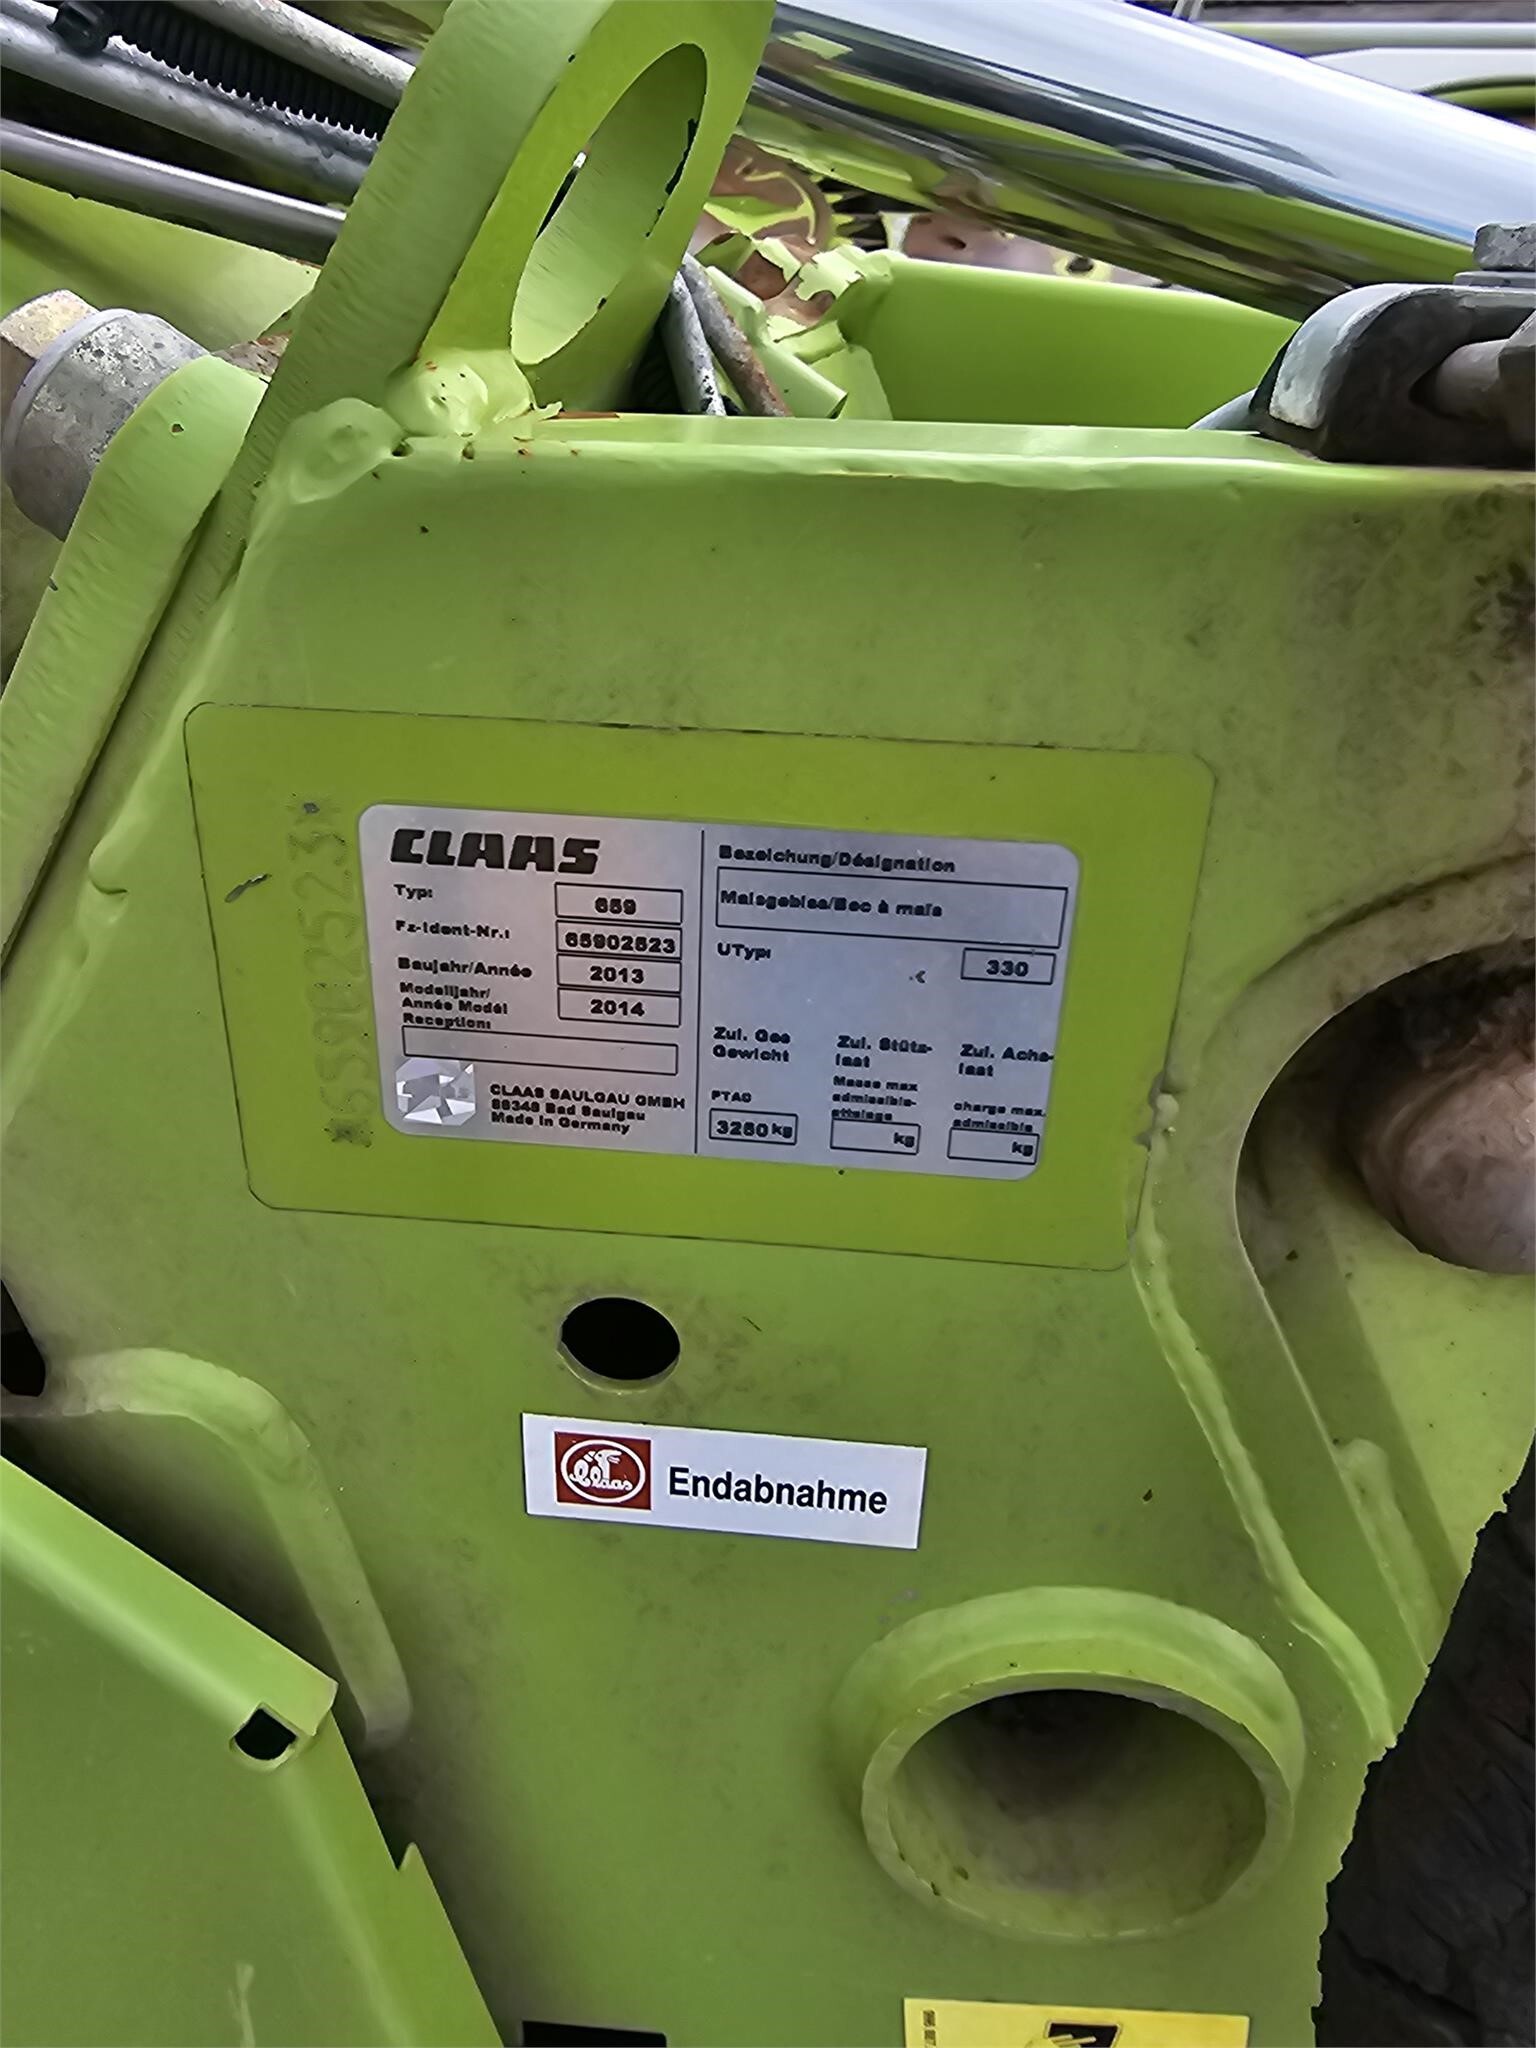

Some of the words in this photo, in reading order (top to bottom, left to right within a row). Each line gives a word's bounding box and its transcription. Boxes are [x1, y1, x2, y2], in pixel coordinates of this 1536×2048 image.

[390, 828, 600, 875] CLAAS
[394, 884, 433, 900] Typ:
[595, 897, 636, 915] 659
[878, 900, 889, 914] à
[717, 942, 771, 961] UTyp:
[986, 959, 1029, 978] 330
[398, 957, 532, 978] Baujahr/Année
[590, 965, 644, 985] 2013
[402, 997, 453, 1011] Année
[590, 999, 645, 1018] 2014
[712, 1045, 790, 1062] Gewicht
[835, 1053, 870, 1068] last
[959, 1063, 994, 1077] last
[490, 1084, 544, 1098] CLAAS
[550, 1089, 630, 1105] SAULGAU
[886, 1079, 918, 1092] max
[546, 1103, 576, 1116] Bad
[582, 1106, 646, 1121] Saulgau
[954, 1101, 1005, 1116] charge
[491, 1112, 533, 1126] Made
[559, 1118, 630, 1135] Germany
[772, 1122, 793, 1140] kg
[894, 1132, 915, 1148] kg
[1012, 1140, 1034, 1157] kg
[669, 1466, 888, 1514] Endabnahme
